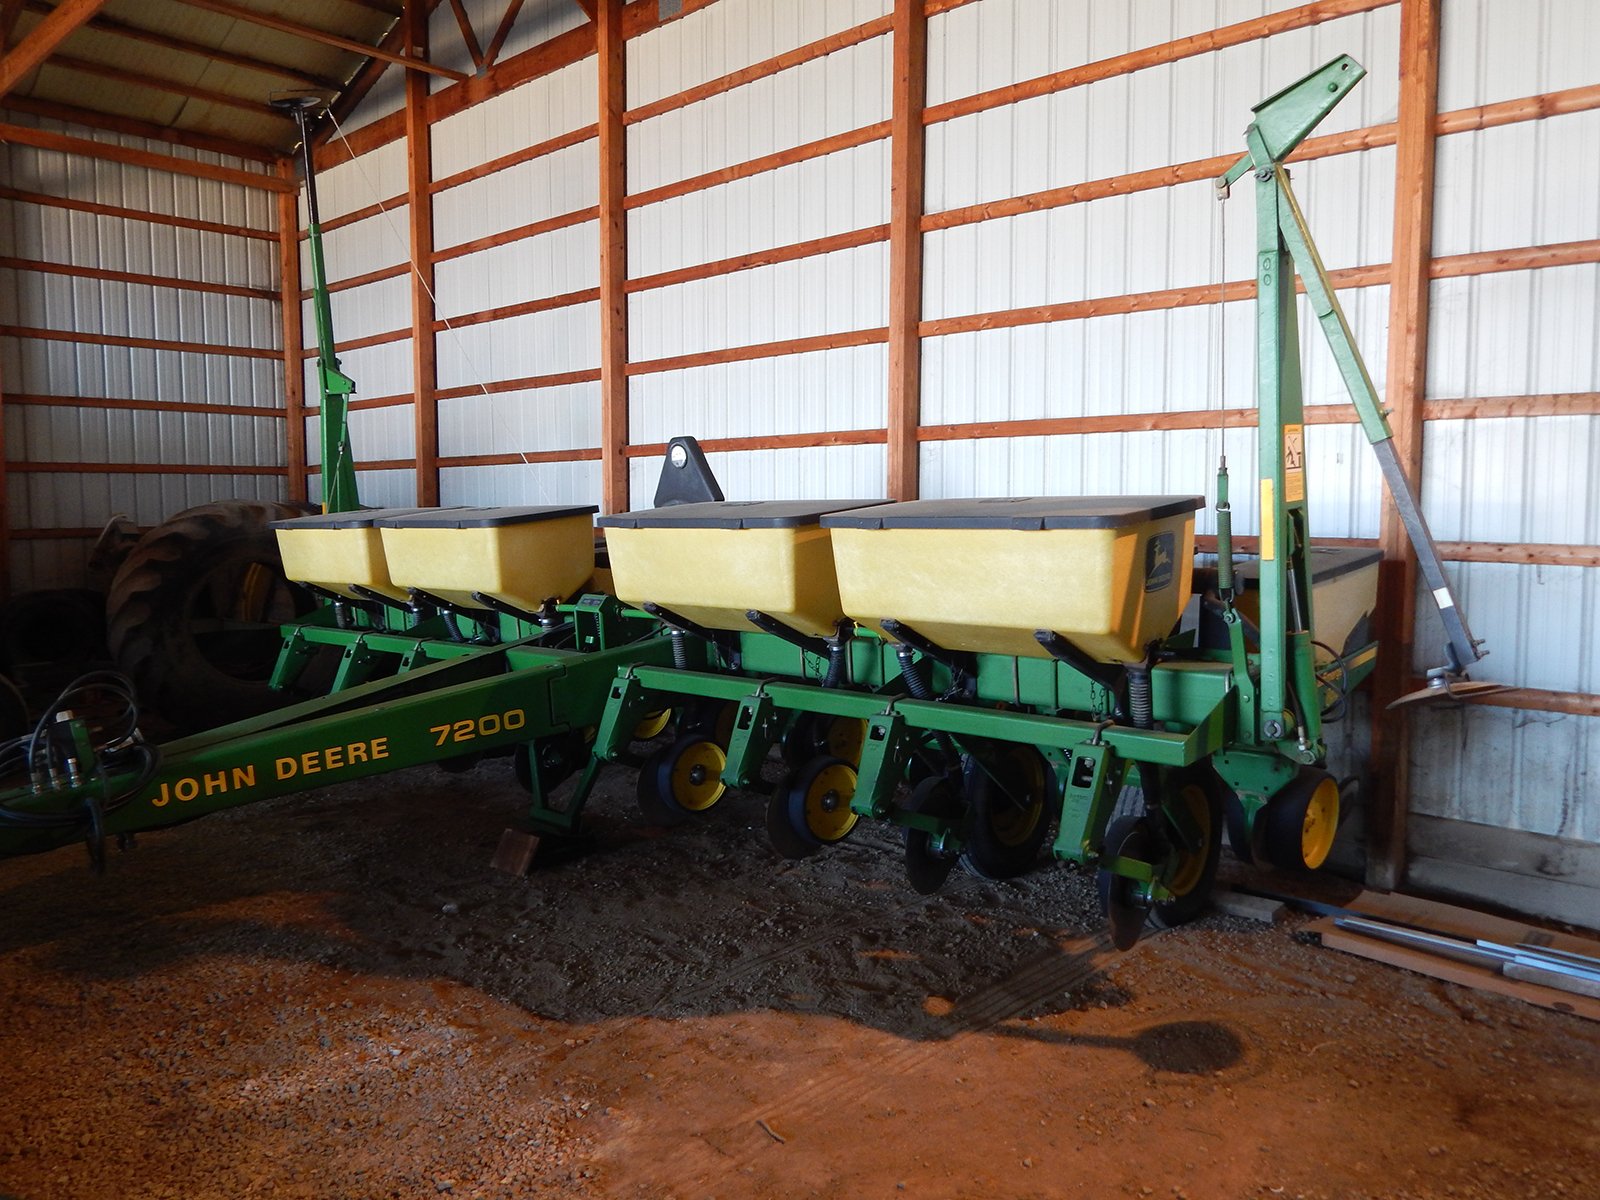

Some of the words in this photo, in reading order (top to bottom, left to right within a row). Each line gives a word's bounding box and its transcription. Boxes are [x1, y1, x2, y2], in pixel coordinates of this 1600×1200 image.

[152, 765, 256, 807] JOHN
[276, 737, 390, 780] DEERE
[429, 708, 526, 746] 7200
